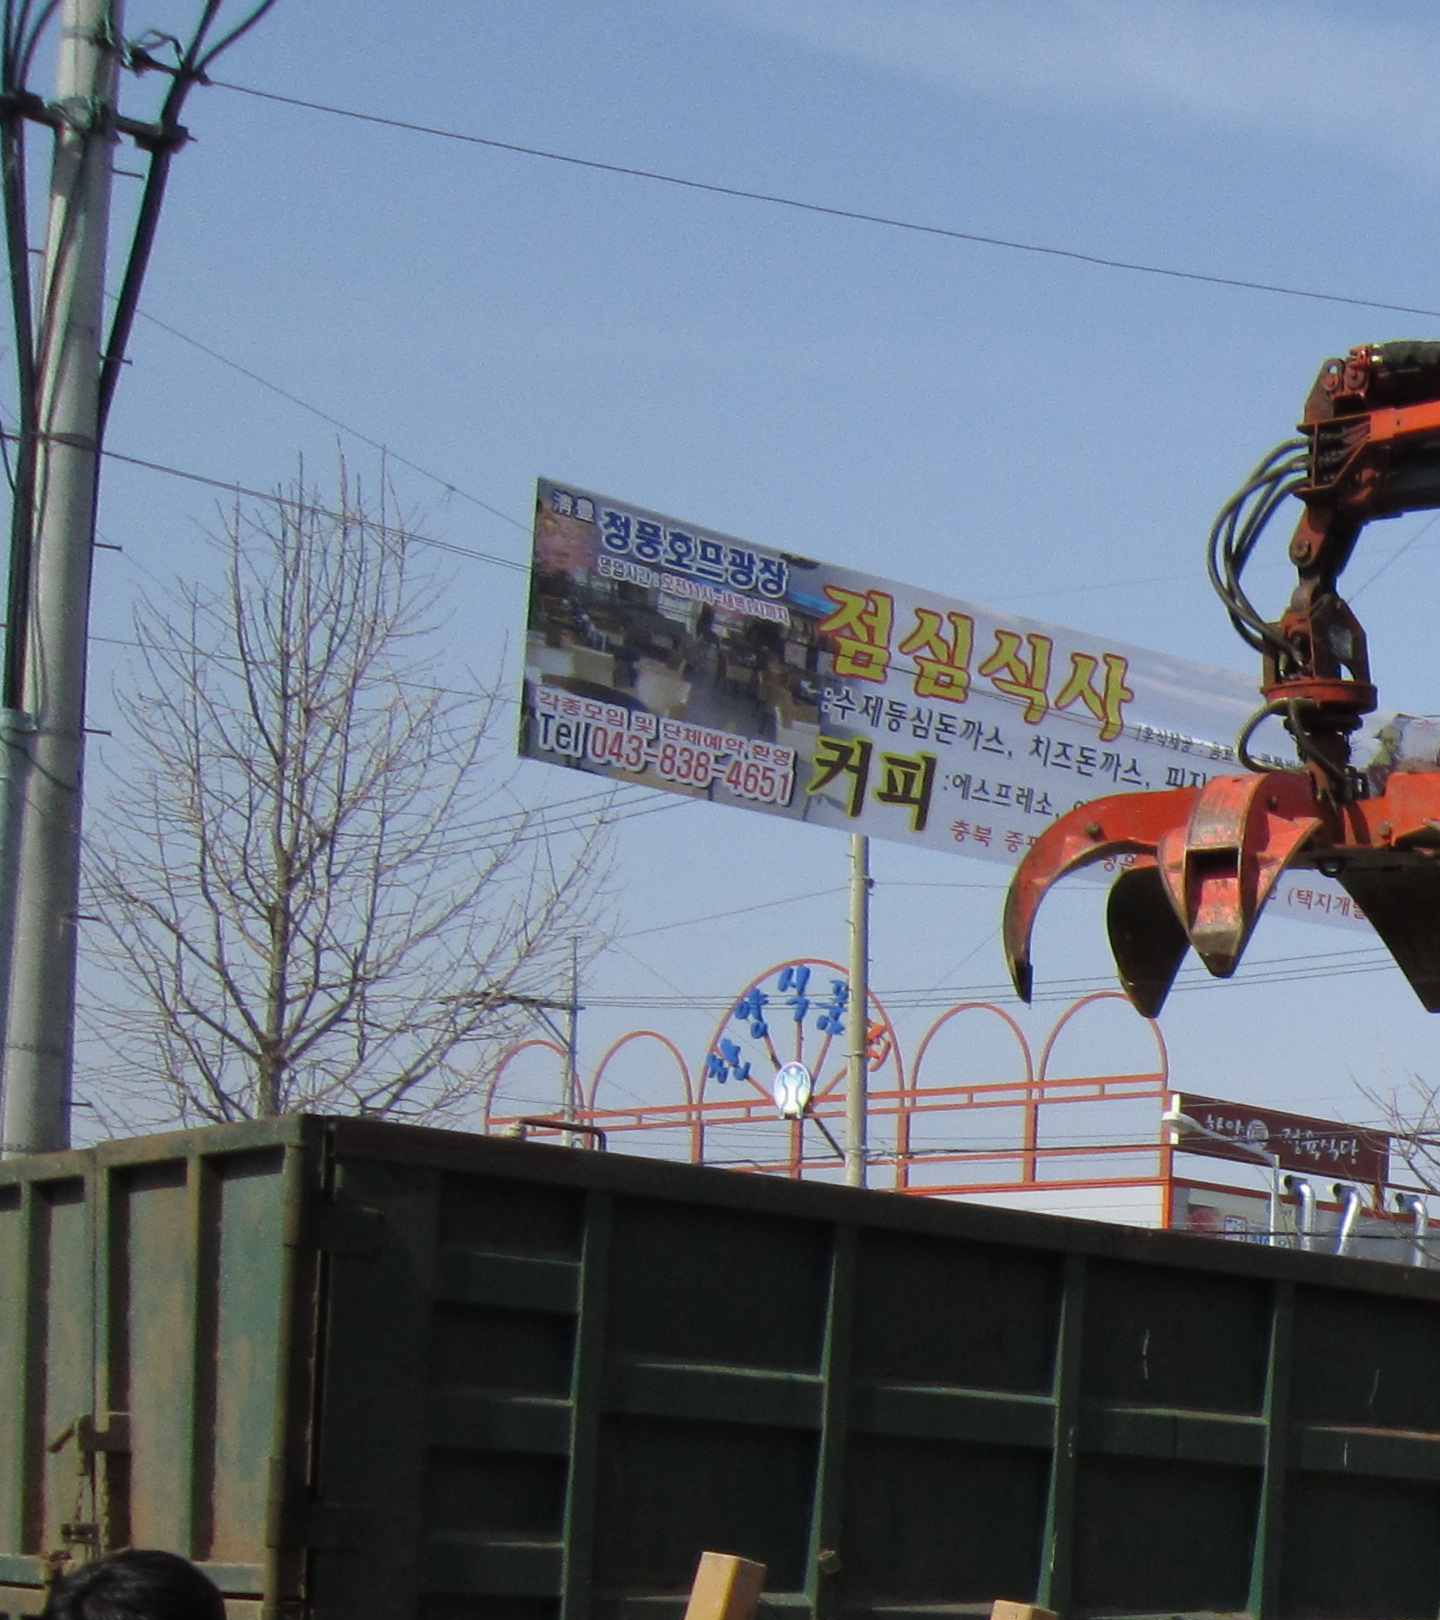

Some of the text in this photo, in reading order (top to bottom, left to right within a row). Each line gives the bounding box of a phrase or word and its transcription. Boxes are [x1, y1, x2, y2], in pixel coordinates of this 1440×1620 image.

[602, 509, 787, 598] 청풍호프광장
[818, 585, 1134, 742] 점심식사
[539, 689, 625, 727] 각종모임
[662, 721, 746, 756] 단체예약
[751, 741, 793, 767] 환영
[540, 712, 792, 804] Tel 043-838-4651
[808, 737, 937, 832] 커피
[952, 820, 993, 846] 충북
